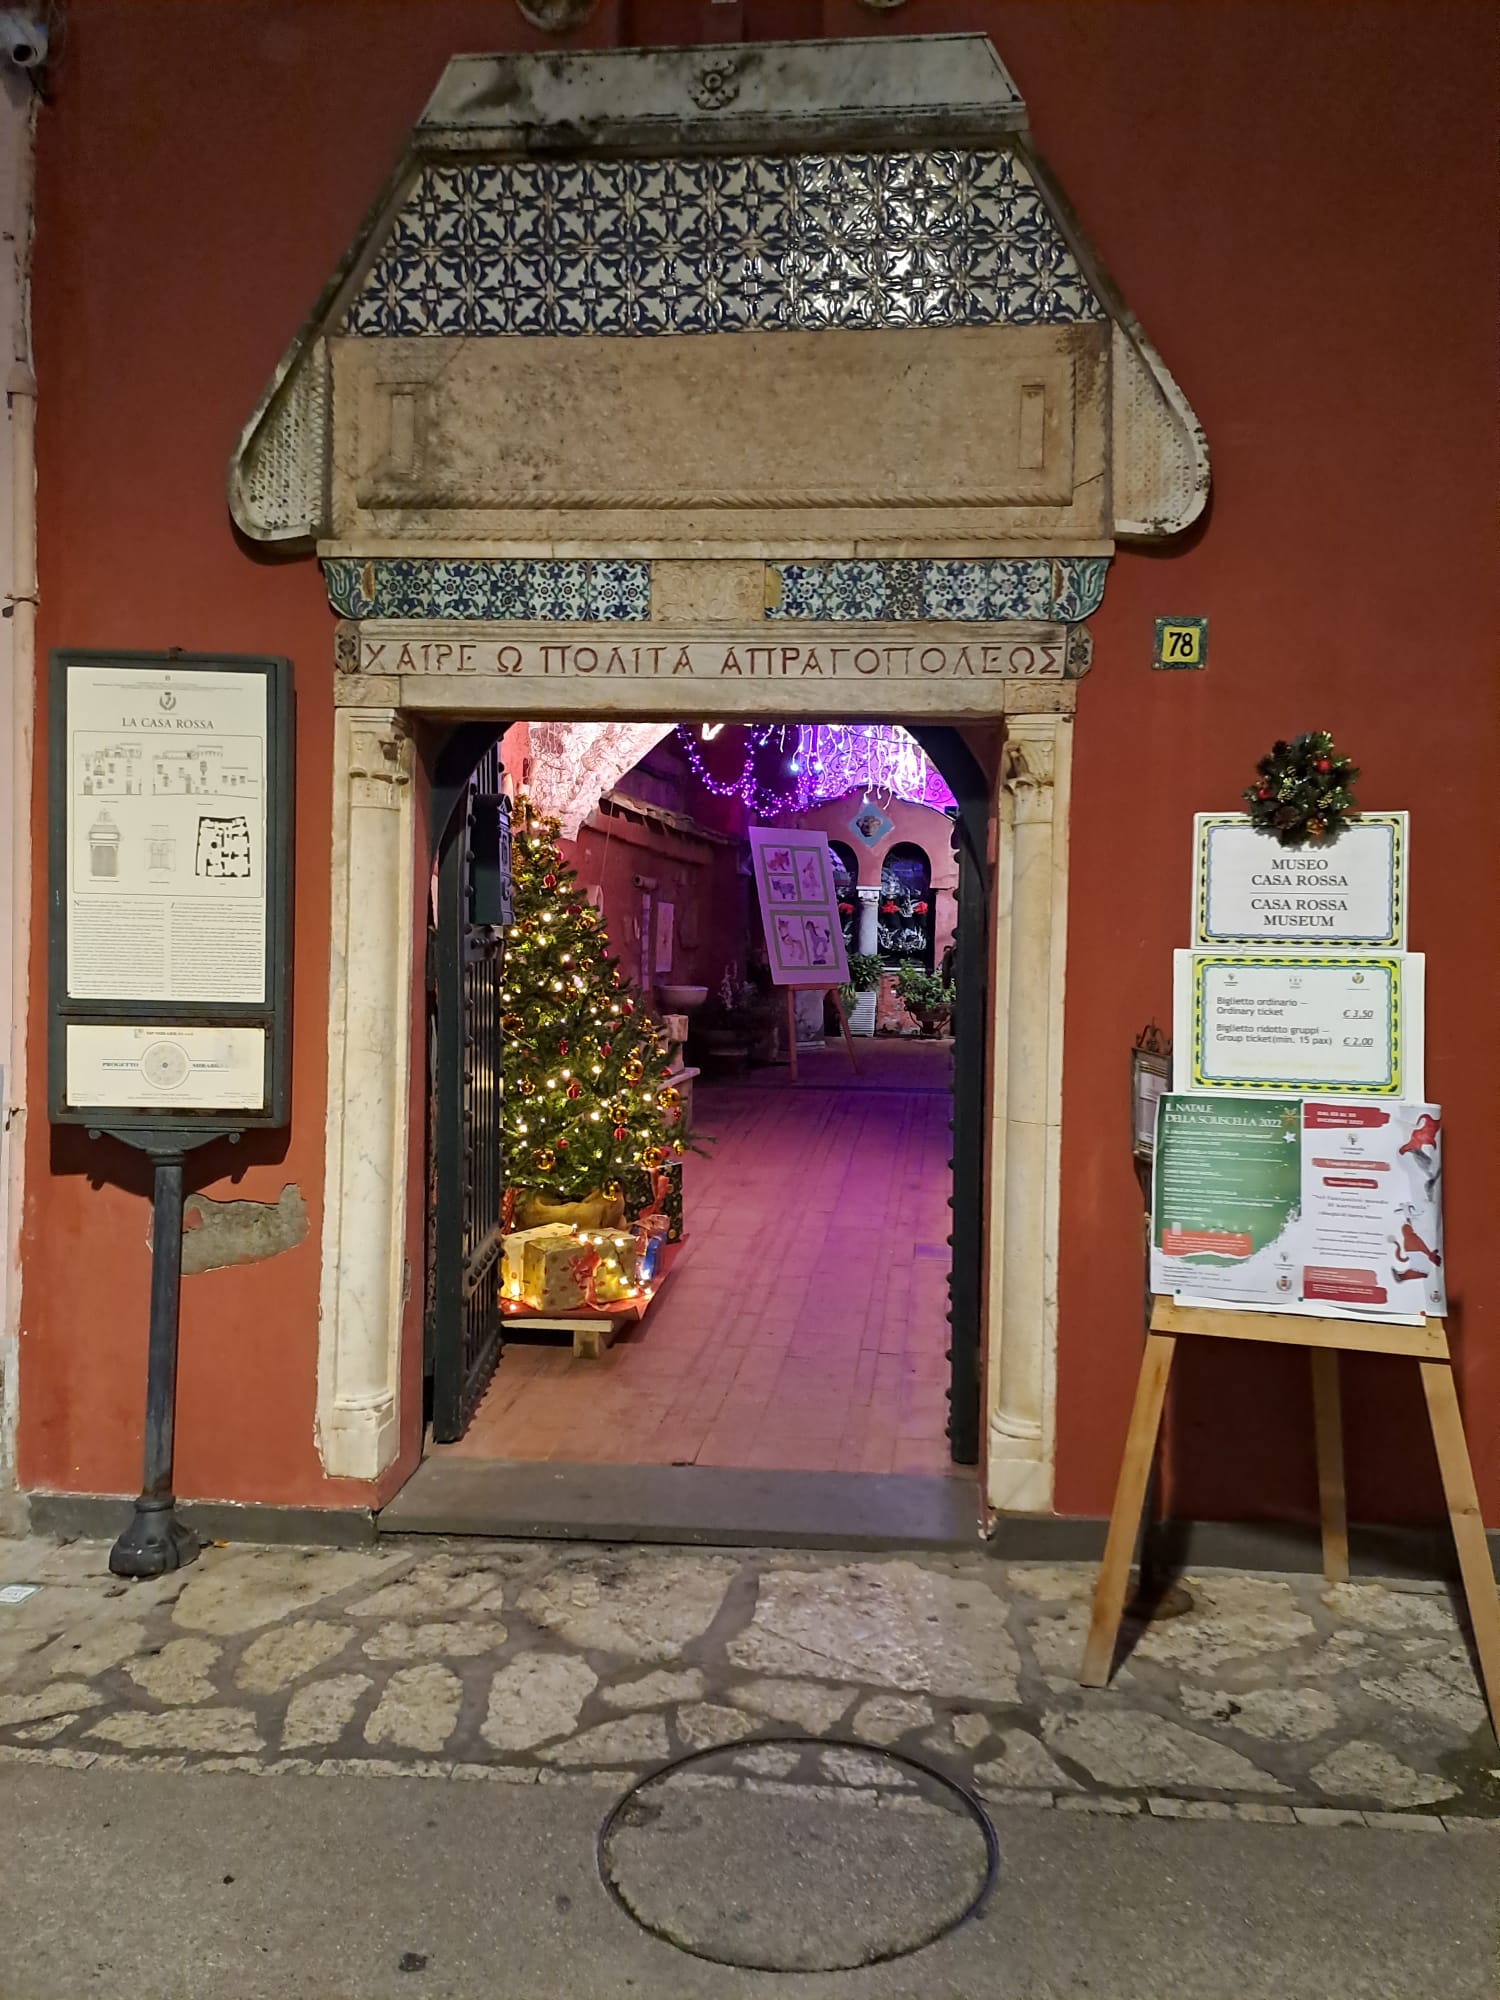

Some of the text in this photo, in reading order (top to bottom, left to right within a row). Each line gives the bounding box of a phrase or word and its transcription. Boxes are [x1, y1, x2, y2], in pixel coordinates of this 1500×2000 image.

[1169, 632, 1194, 657] 78
[497, 645, 523, 673] Ω
[122, 717, 214, 729] LA CASA ROSSA
[1271, 859, 1329, 870] MUSEO
[1251, 874, 1348, 886] CASA ROSSA
[1251, 898, 1348, 911] CASA ROSSA
[1263, 914, 1335, 927] MUSEUM
[1216, 996, 1255, 1006] Biglietto
[1256, 998, 1298, 1007] ordinario
[1216, 1006, 1284, 1016] Ordinary ticket
[1216, 1024, 1255, 1034] Biglietto
[1256, 1025, 1288, 1034] ridotto
[1290, 1027, 1320, 1036] gruppi
[1216, 1033, 1243, 1043] Group
[1299, 1036, 1310, 1044] 15
[1175, 1103, 1214, 1113] NATALE
[1165, 1114, 1198, 1123] DELLA
